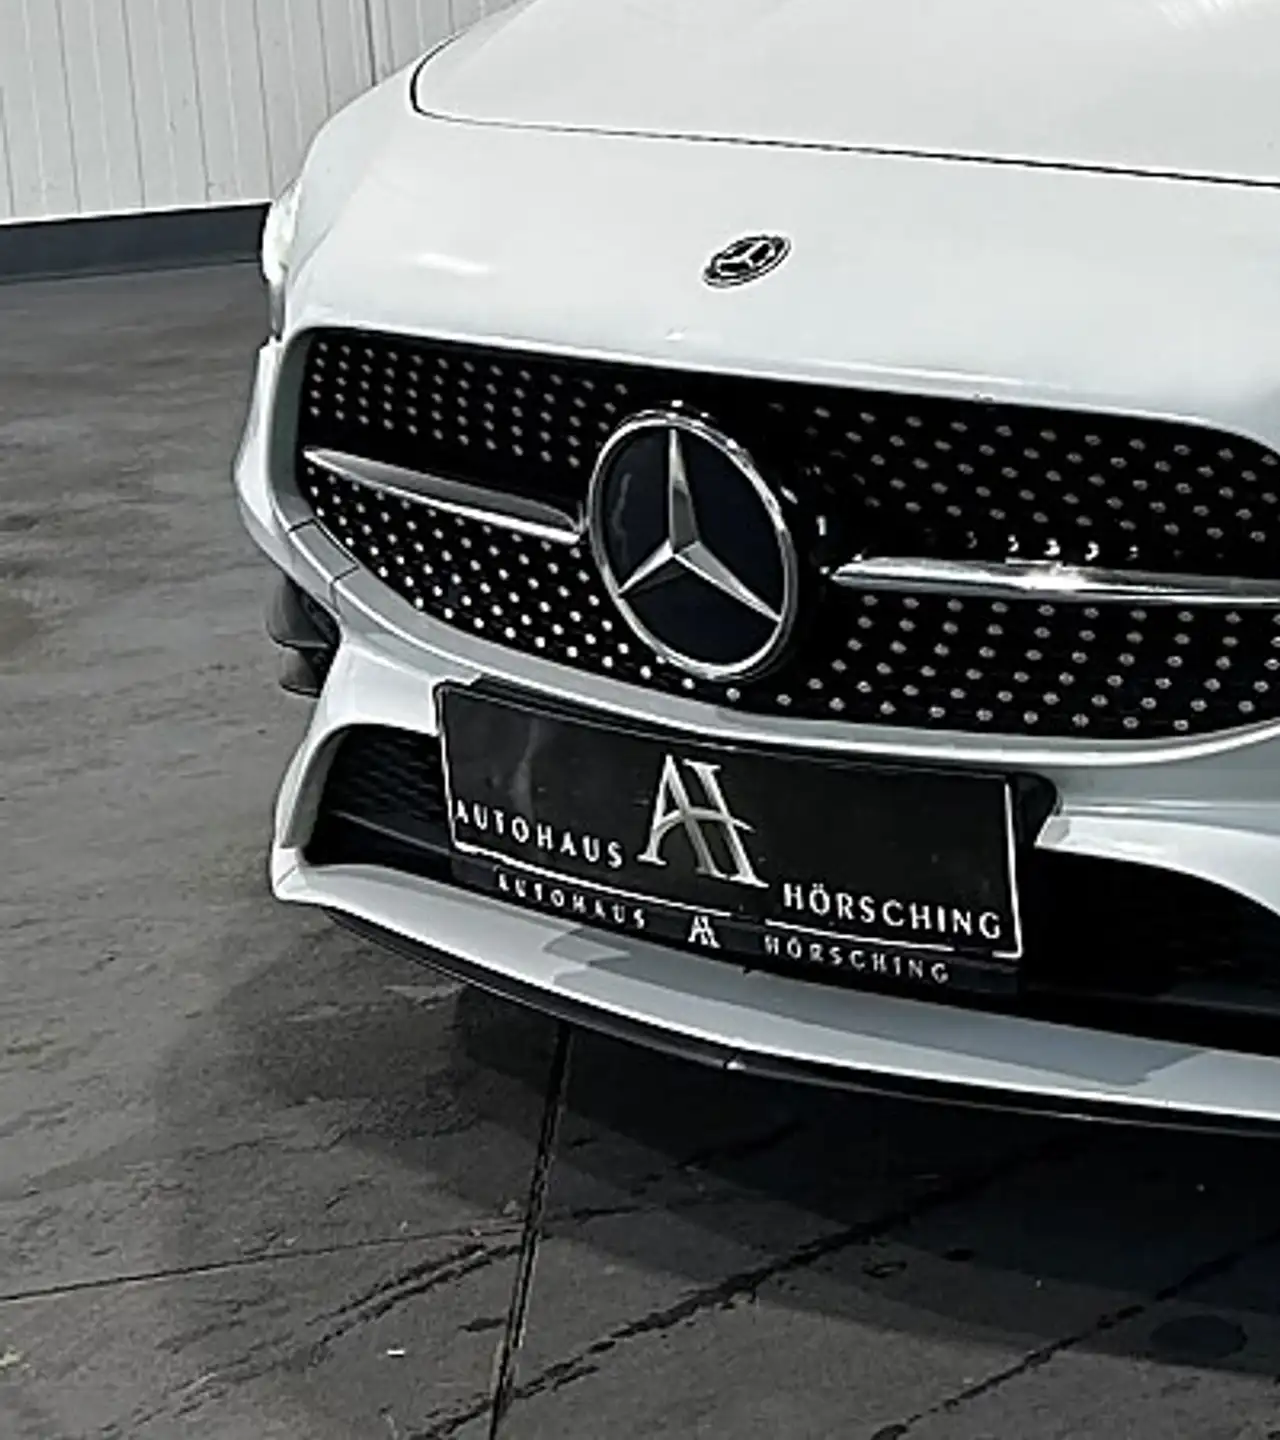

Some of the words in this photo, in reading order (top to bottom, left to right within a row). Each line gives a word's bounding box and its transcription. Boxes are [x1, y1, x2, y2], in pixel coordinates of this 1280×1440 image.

[456, 800, 622, 868] AUTOHAUS
[783, 882, 1001, 939] HÖRSCHING
[498, 873, 646, 928] AUTOHAUS
